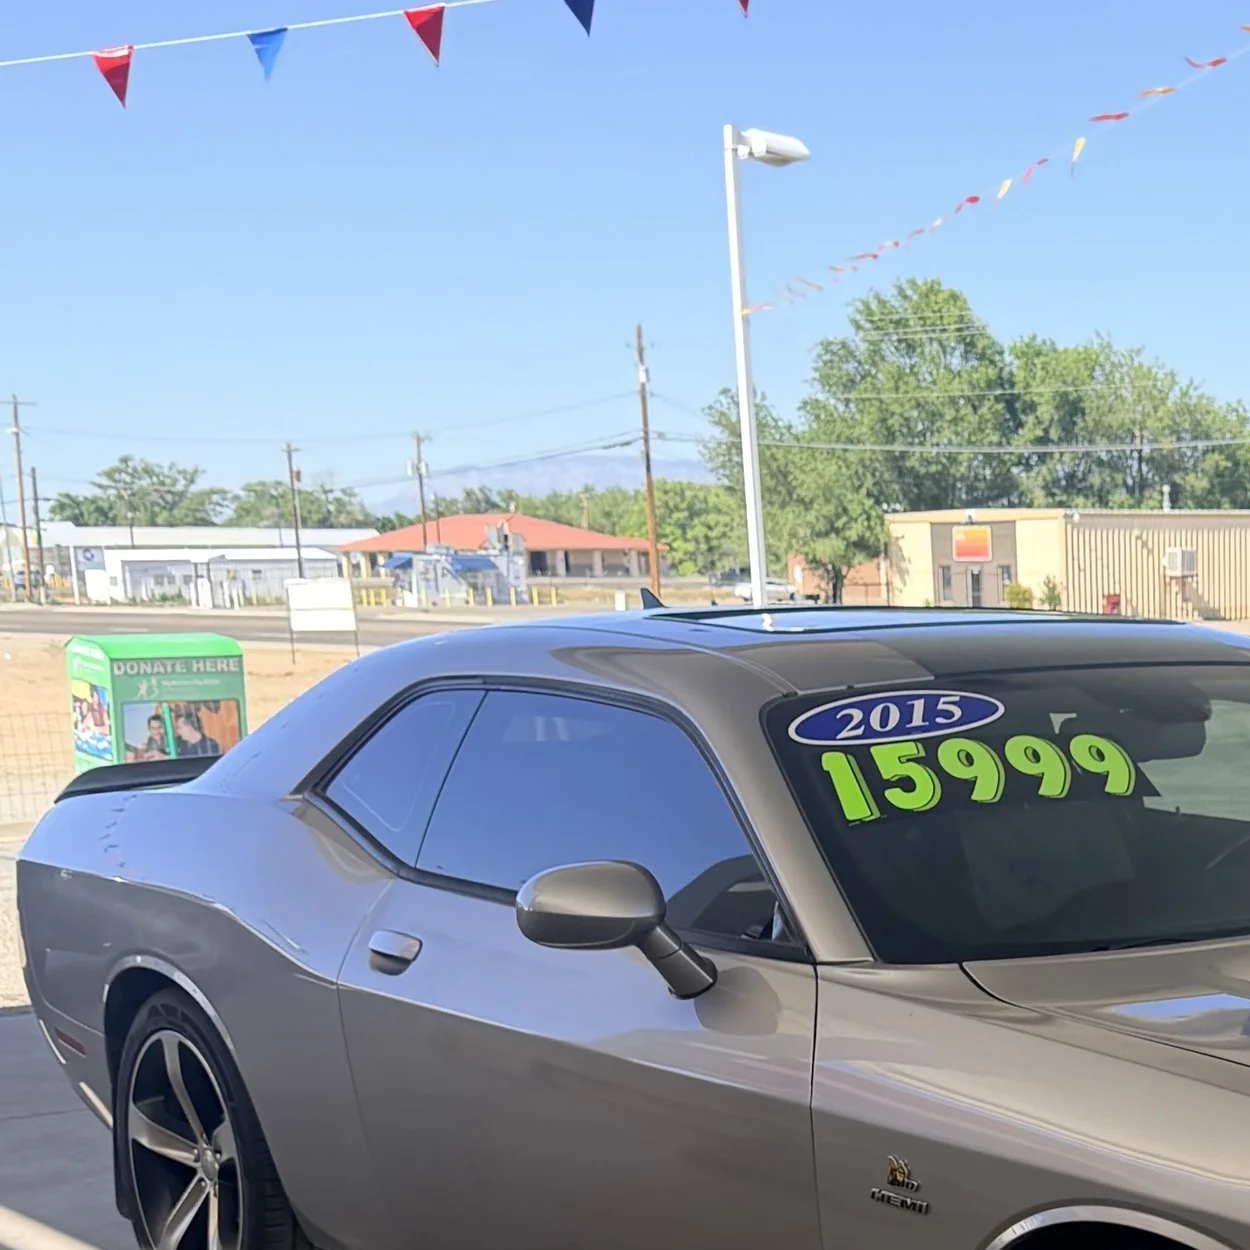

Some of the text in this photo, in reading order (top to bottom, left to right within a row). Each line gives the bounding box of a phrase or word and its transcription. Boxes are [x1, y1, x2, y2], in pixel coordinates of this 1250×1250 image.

[113, 657, 240, 675] DONATE HERE
[835, 695, 963, 740] 2015
[821, 734, 1136, 822] 15999
[870, 1187, 929, 1215] HEMI
